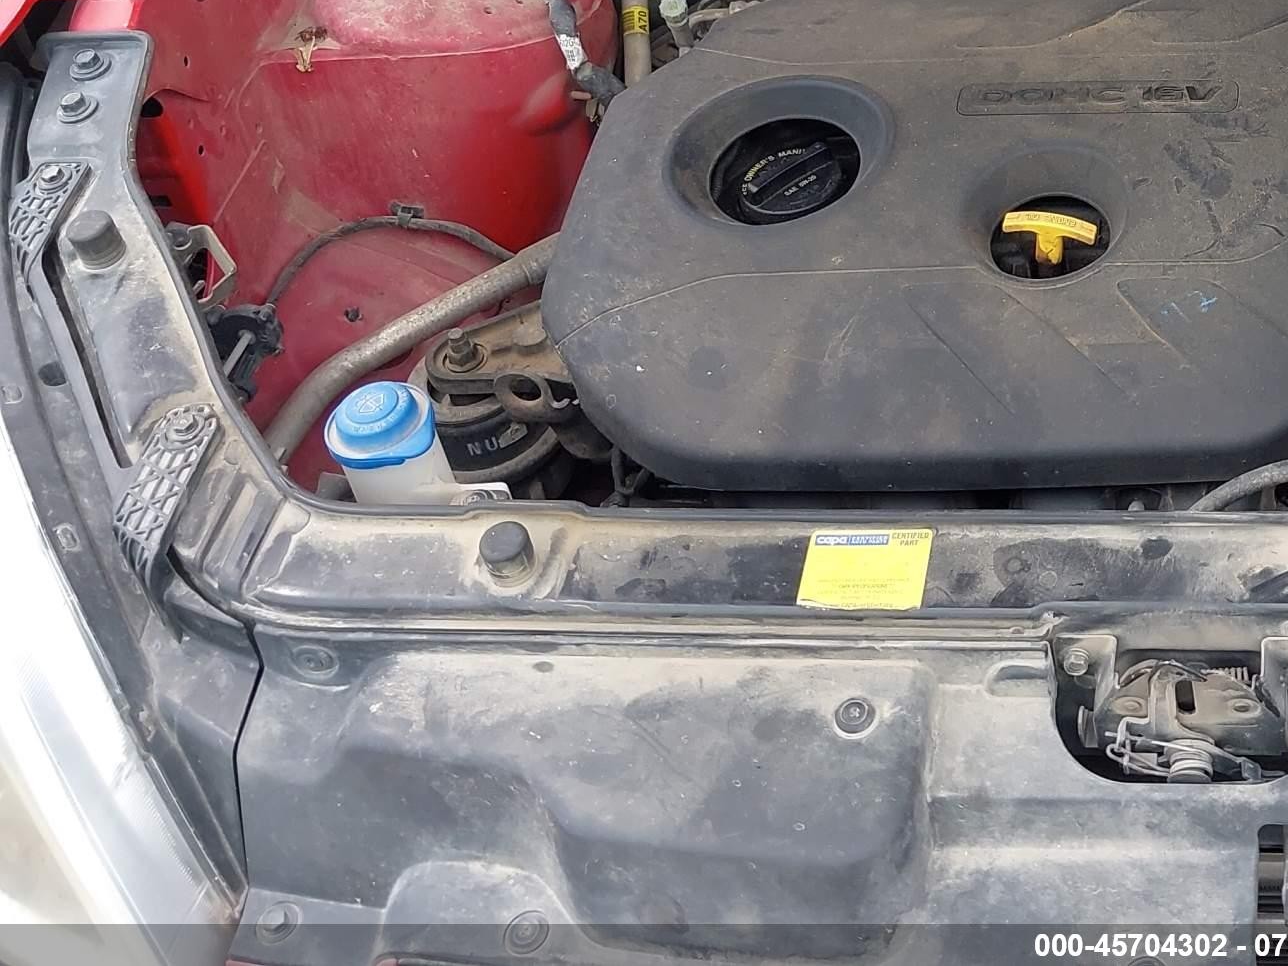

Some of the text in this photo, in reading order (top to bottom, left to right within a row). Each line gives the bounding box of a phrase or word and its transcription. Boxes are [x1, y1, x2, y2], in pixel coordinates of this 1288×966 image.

[638, 10, 648, 32] A70
[983, 84, 1223, 104] DOHC 16V
[744, 155, 775, 181] OWNER'S
[816, 536, 848, 545] capa
[891, 532, 929, 540] CERTIFIED
